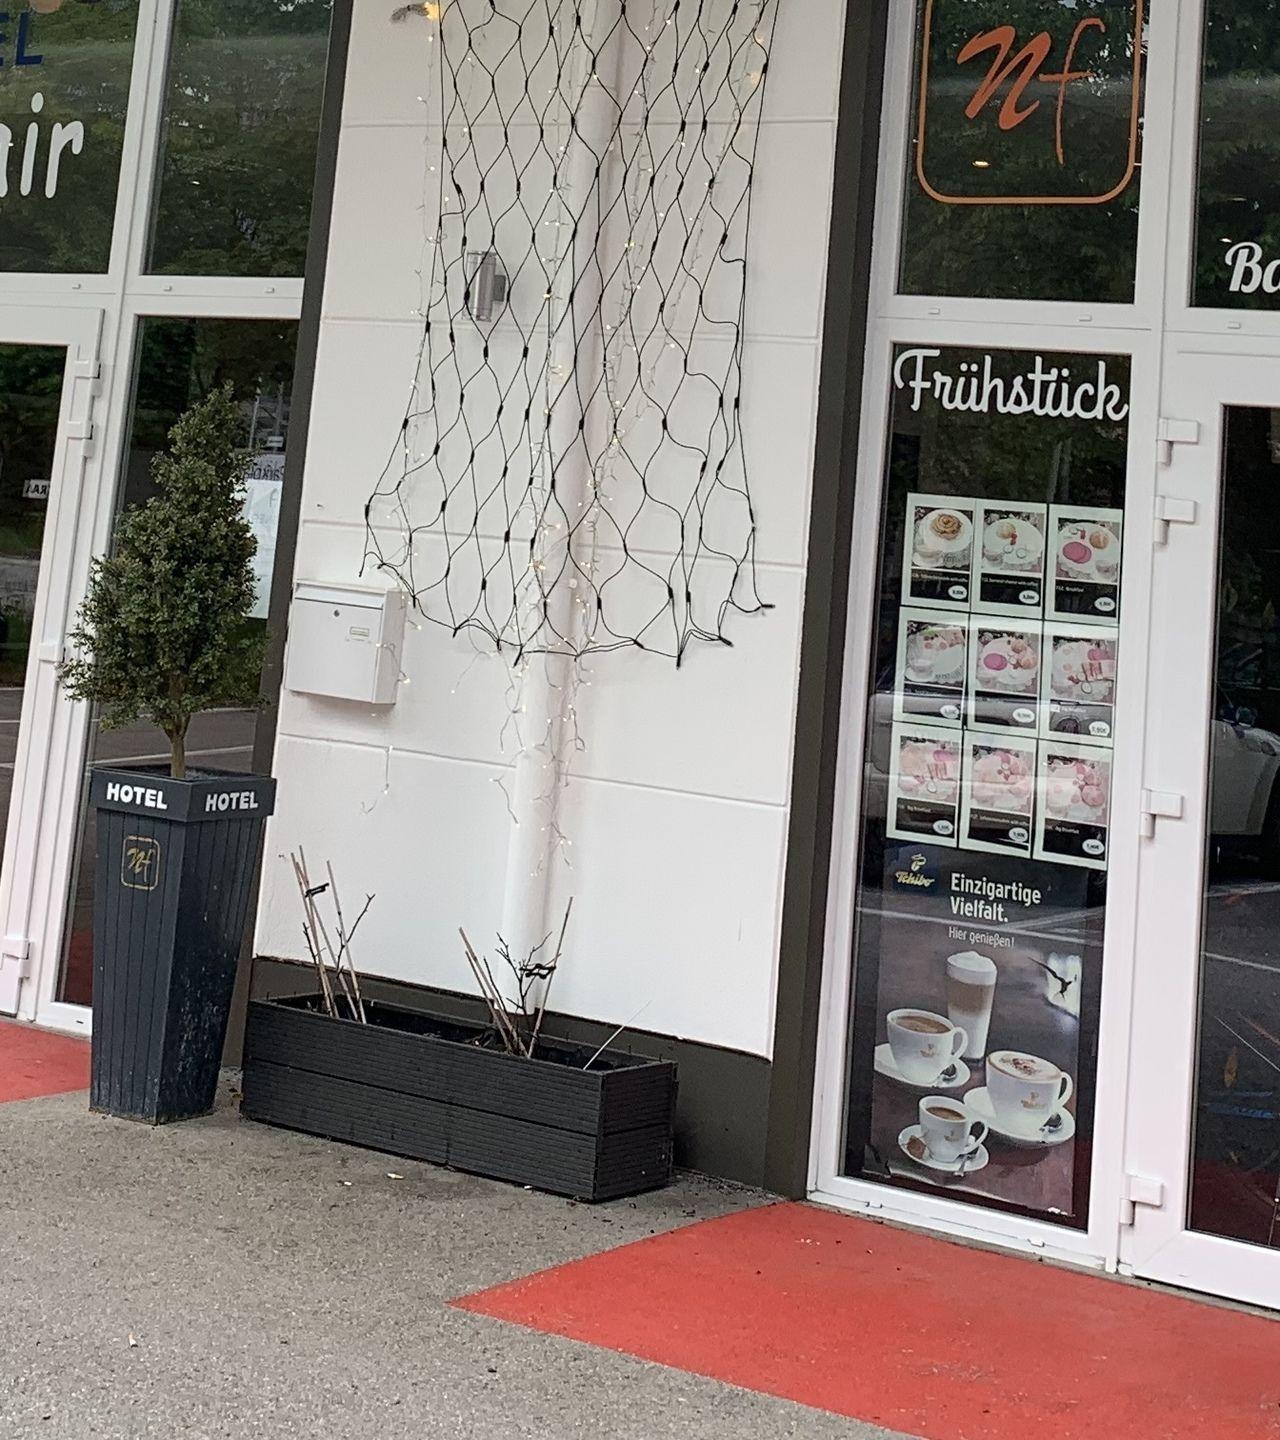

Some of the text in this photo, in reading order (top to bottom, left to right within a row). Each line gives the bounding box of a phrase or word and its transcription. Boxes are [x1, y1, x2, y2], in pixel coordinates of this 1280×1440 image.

[893, 348, 1129, 421] Frühstück
[106, 782, 168, 810] HOTEL
[205, 791, 259, 812] HOTEL
[895, 871, 935, 887] Tchibo
[950, 873, 1042, 907] Einzigartige
[949, 896, 1009, 923] Vielfalt.
[948, 927, 967, 941] Hier
